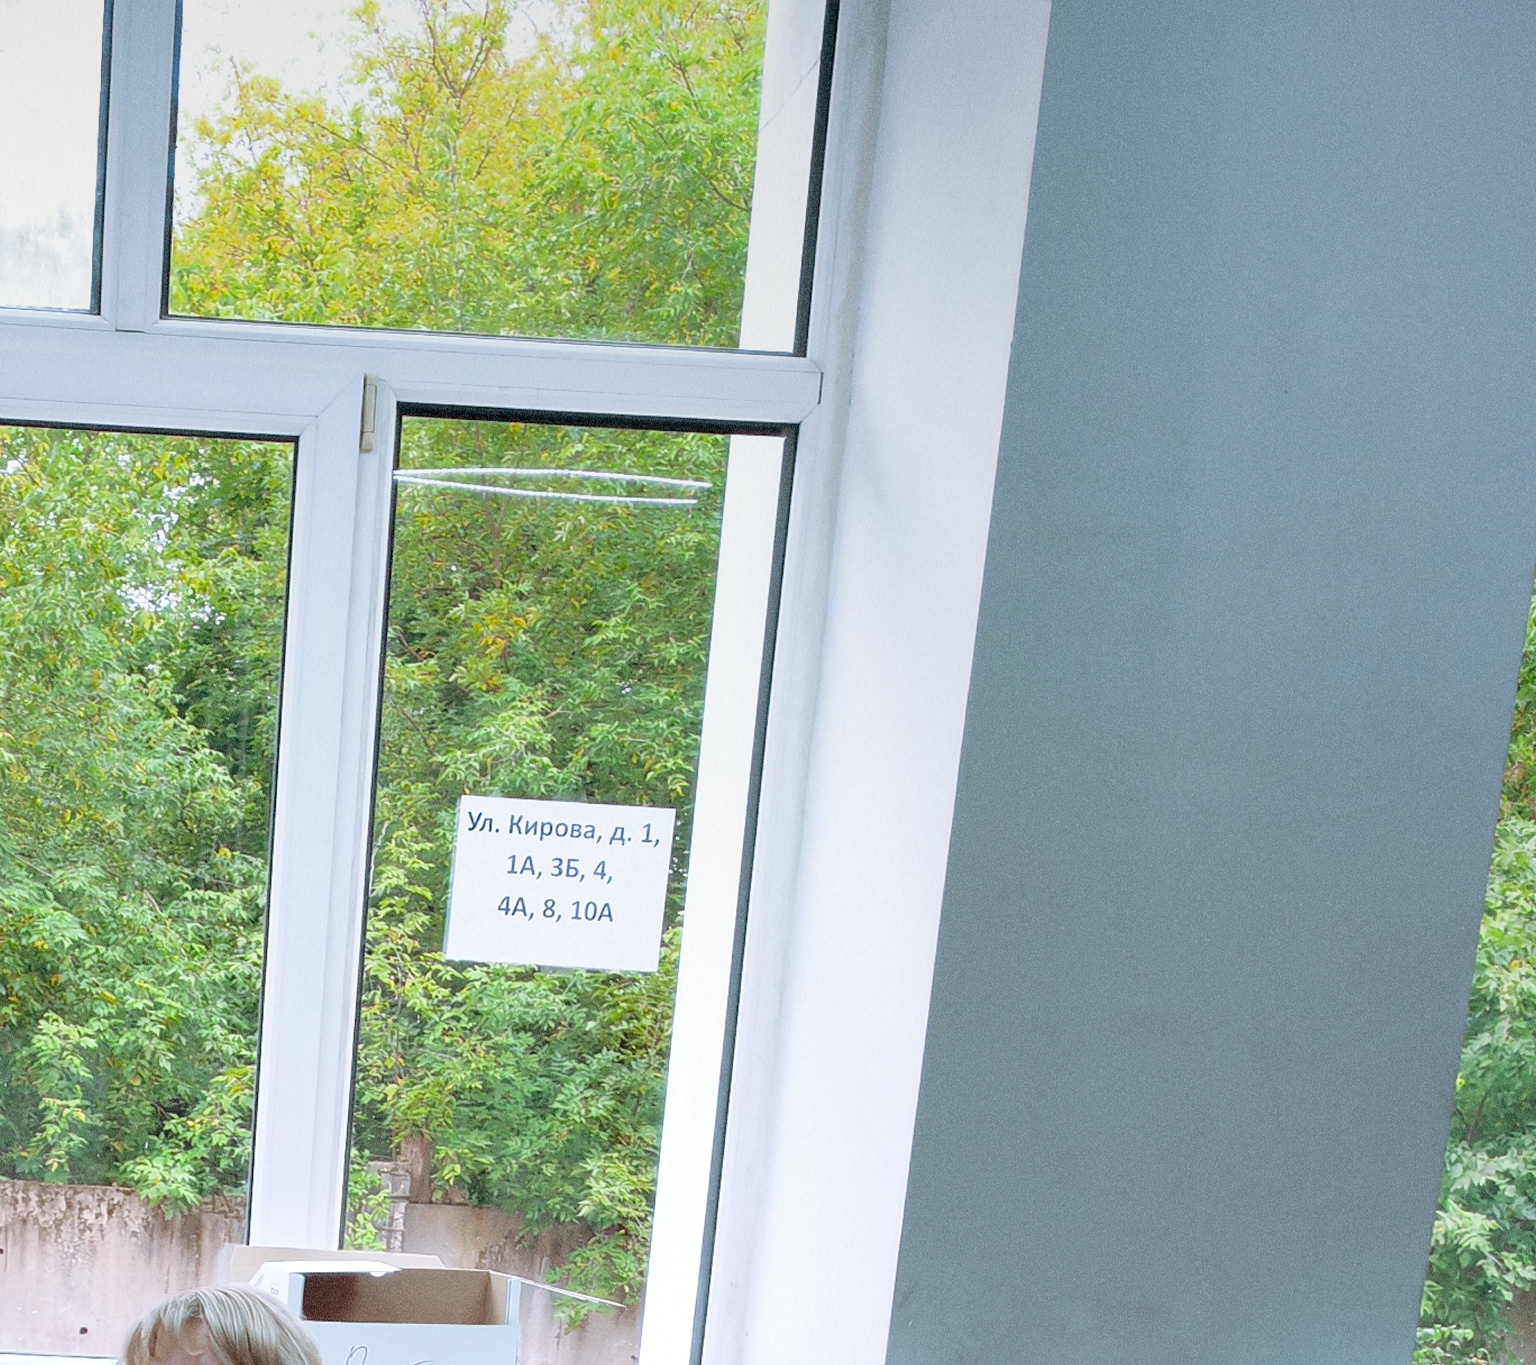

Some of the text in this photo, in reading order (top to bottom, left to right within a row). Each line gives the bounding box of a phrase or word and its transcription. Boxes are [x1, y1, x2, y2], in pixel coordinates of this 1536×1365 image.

[467, 811, 661, 848] Ул. Кирова, д. 1,
[506, 853, 614, 885] 1А, 3Б, 4,
[497, 895, 614, 923] 4А, 8, 10А
